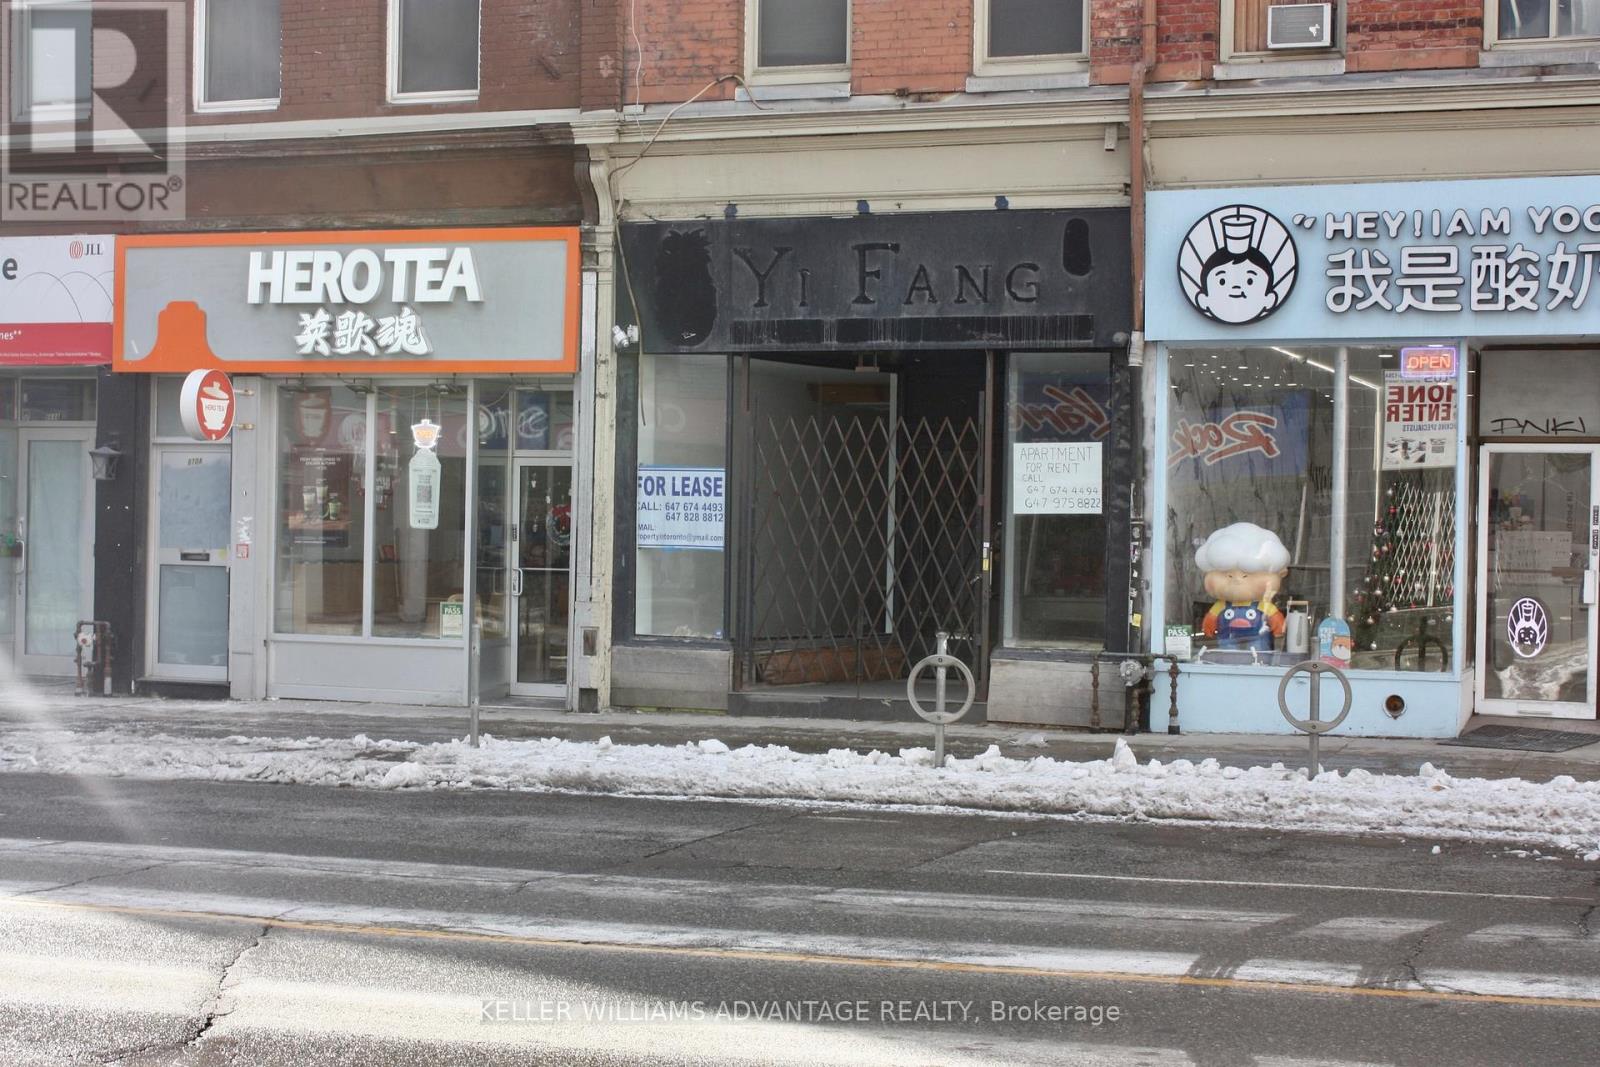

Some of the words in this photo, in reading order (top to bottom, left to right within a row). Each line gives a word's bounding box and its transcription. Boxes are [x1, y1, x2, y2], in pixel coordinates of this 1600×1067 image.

[84, 243, 103, 256] JLL
[851, 242, 1042, 304] FANG
[1407, 354, 1451, 369] OPEN
[1020, 447, 1093, 461] APARTMENT
[1026, 463, 1042, 472] FOR
[1048, 463, 1080, 473] RENT
[1022, 474, 1044, 482] CALL
[672, 476, 723, 497] LEASE
[1049, 486, 1068, 494] 674
[665, 502, 680, 511] 647
[683, 502, 699, 511] 674
[702, 503, 723, 512] 4493
[1025, 498, 1048, 508] 647
[1077, 498, 1101, 509] 8822
[665, 512, 681, 521] 647
[684, 513, 699, 522] 828
[703, 513, 724, 522] 8812
[444, 607, 461, 615] PASS
[1168, 629, 1188, 637] PASS
